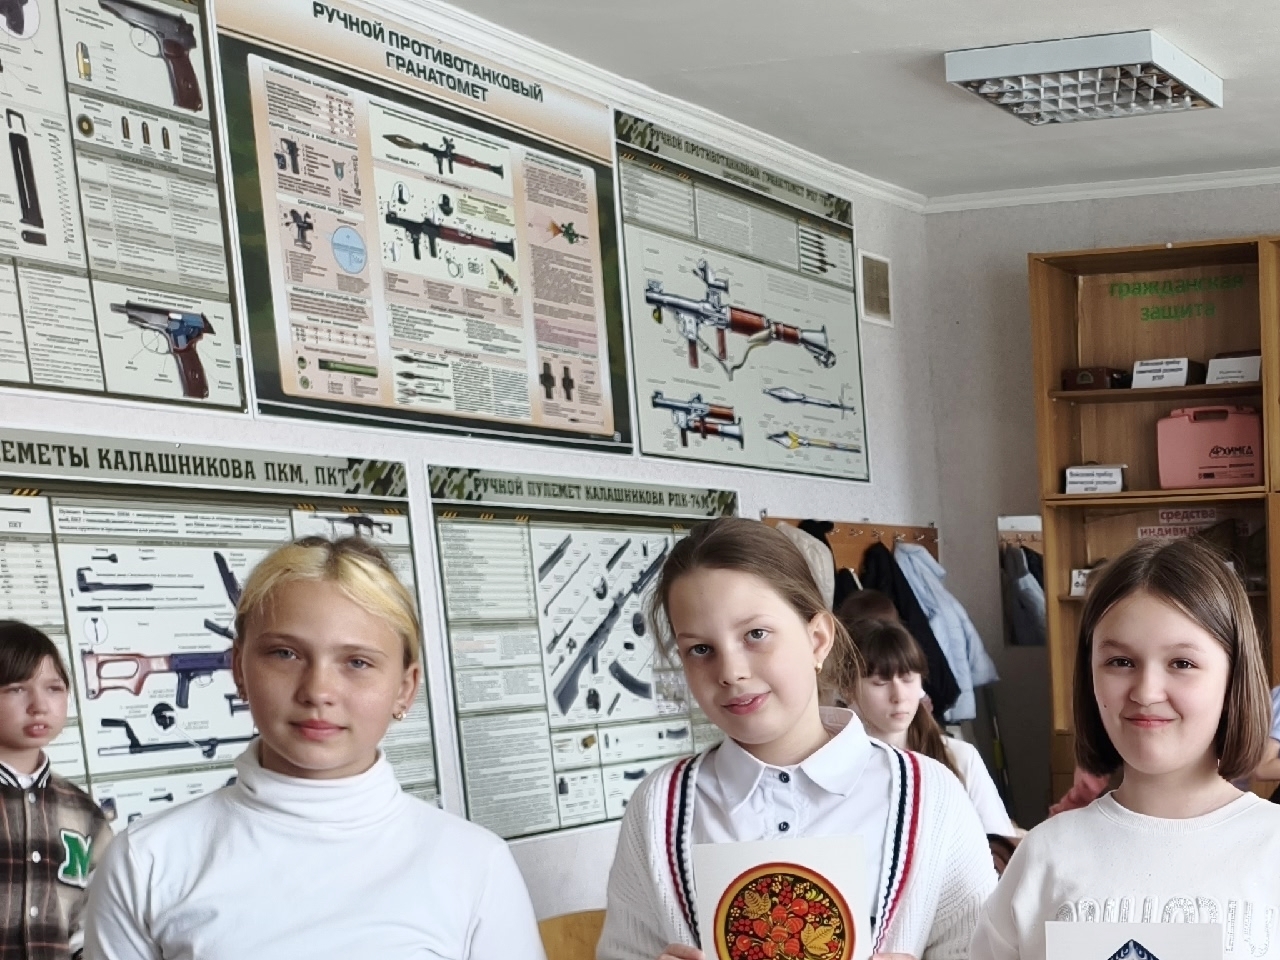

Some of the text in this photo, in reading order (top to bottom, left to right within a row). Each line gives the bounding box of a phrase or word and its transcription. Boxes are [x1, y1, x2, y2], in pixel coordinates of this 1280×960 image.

[313, 2, 384, 43] РУЧНОЙ
[389, 30, 544, 102] ПРОТИВОТАНКОВЫЙ
[386, 52, 489, 102] ГРАНАТОМЕТ
[1109, 275, 1244, 300] гражданская
[1140, 304, 1215, 322] защита
[0, 440, 348, 487] ЕМЕТЫ КАЛАШНИКОВА ПКМ, ПКТ
[473, 476, 523, 496] РУЧНОЙ
[527, 480, 582, 501] ПУЛЕМЕТ
[585, 484, 665, 506] КАЛАШНИКОВА
[1160, 510, 1216, 523] средства
